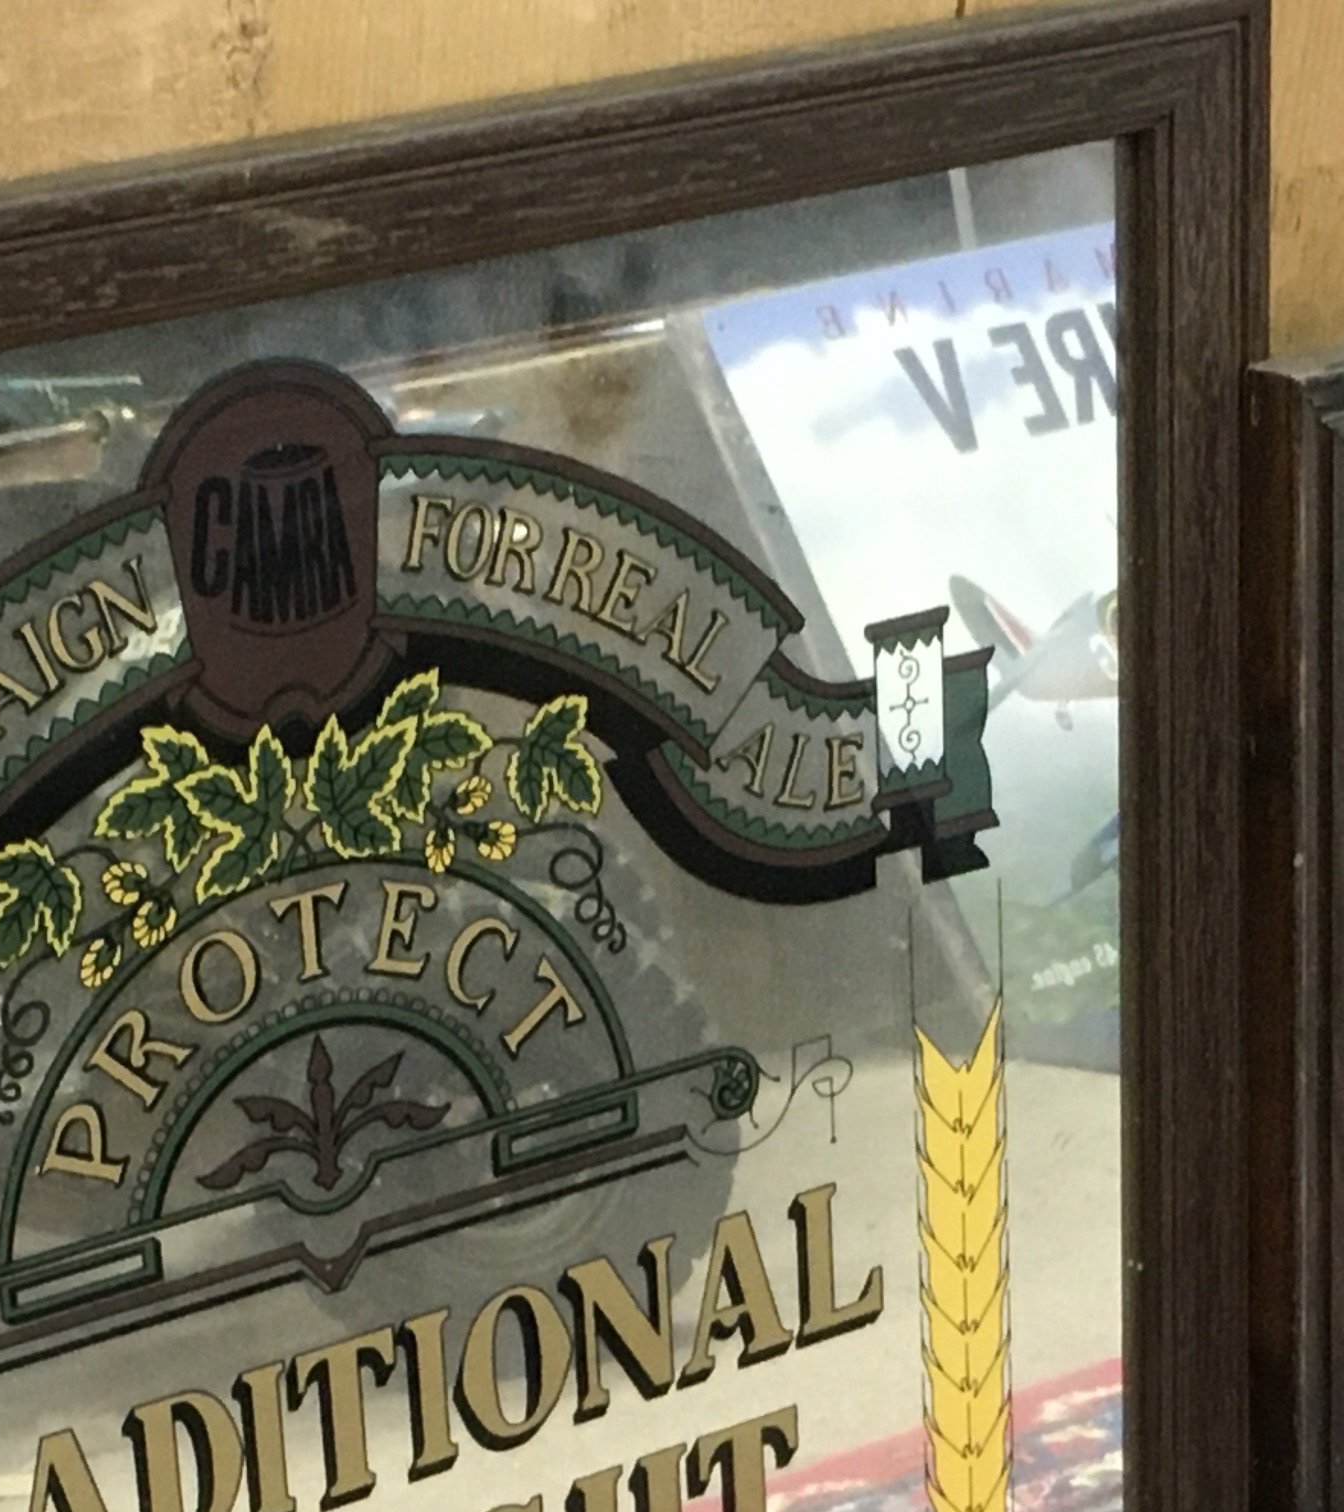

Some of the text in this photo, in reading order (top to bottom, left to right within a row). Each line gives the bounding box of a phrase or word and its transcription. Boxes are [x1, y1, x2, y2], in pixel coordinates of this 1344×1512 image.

[191, 465, 357, 625] CAMRA
[402, 494, 866, 813] FOR REAL ALE
[42, 879, 588, 1187] PROTECT
